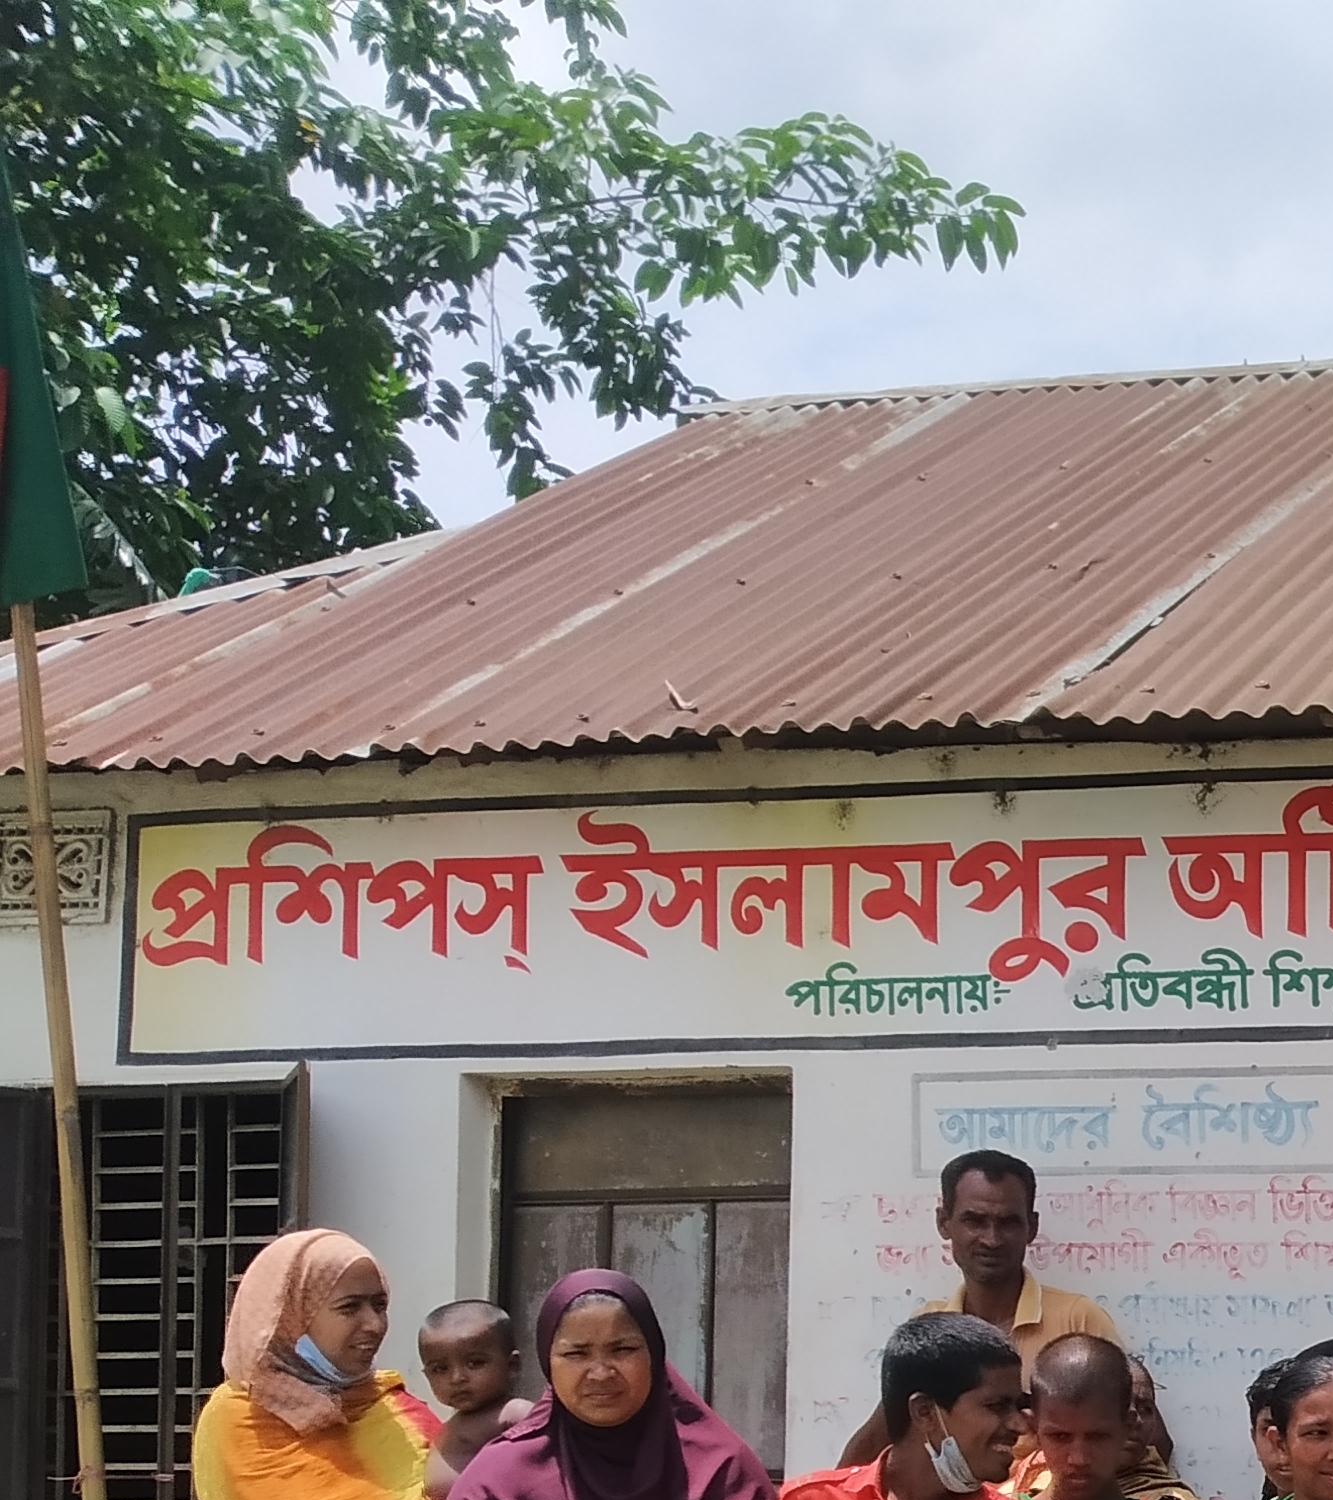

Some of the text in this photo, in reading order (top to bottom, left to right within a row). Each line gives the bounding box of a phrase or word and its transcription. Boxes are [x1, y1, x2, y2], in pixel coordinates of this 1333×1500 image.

[140, 825, 544, 971] প্রশিপস্
[560, 810, 1144, 984] ইসলামপুর
[934, 1106, 1118, 1153] আমাদের
